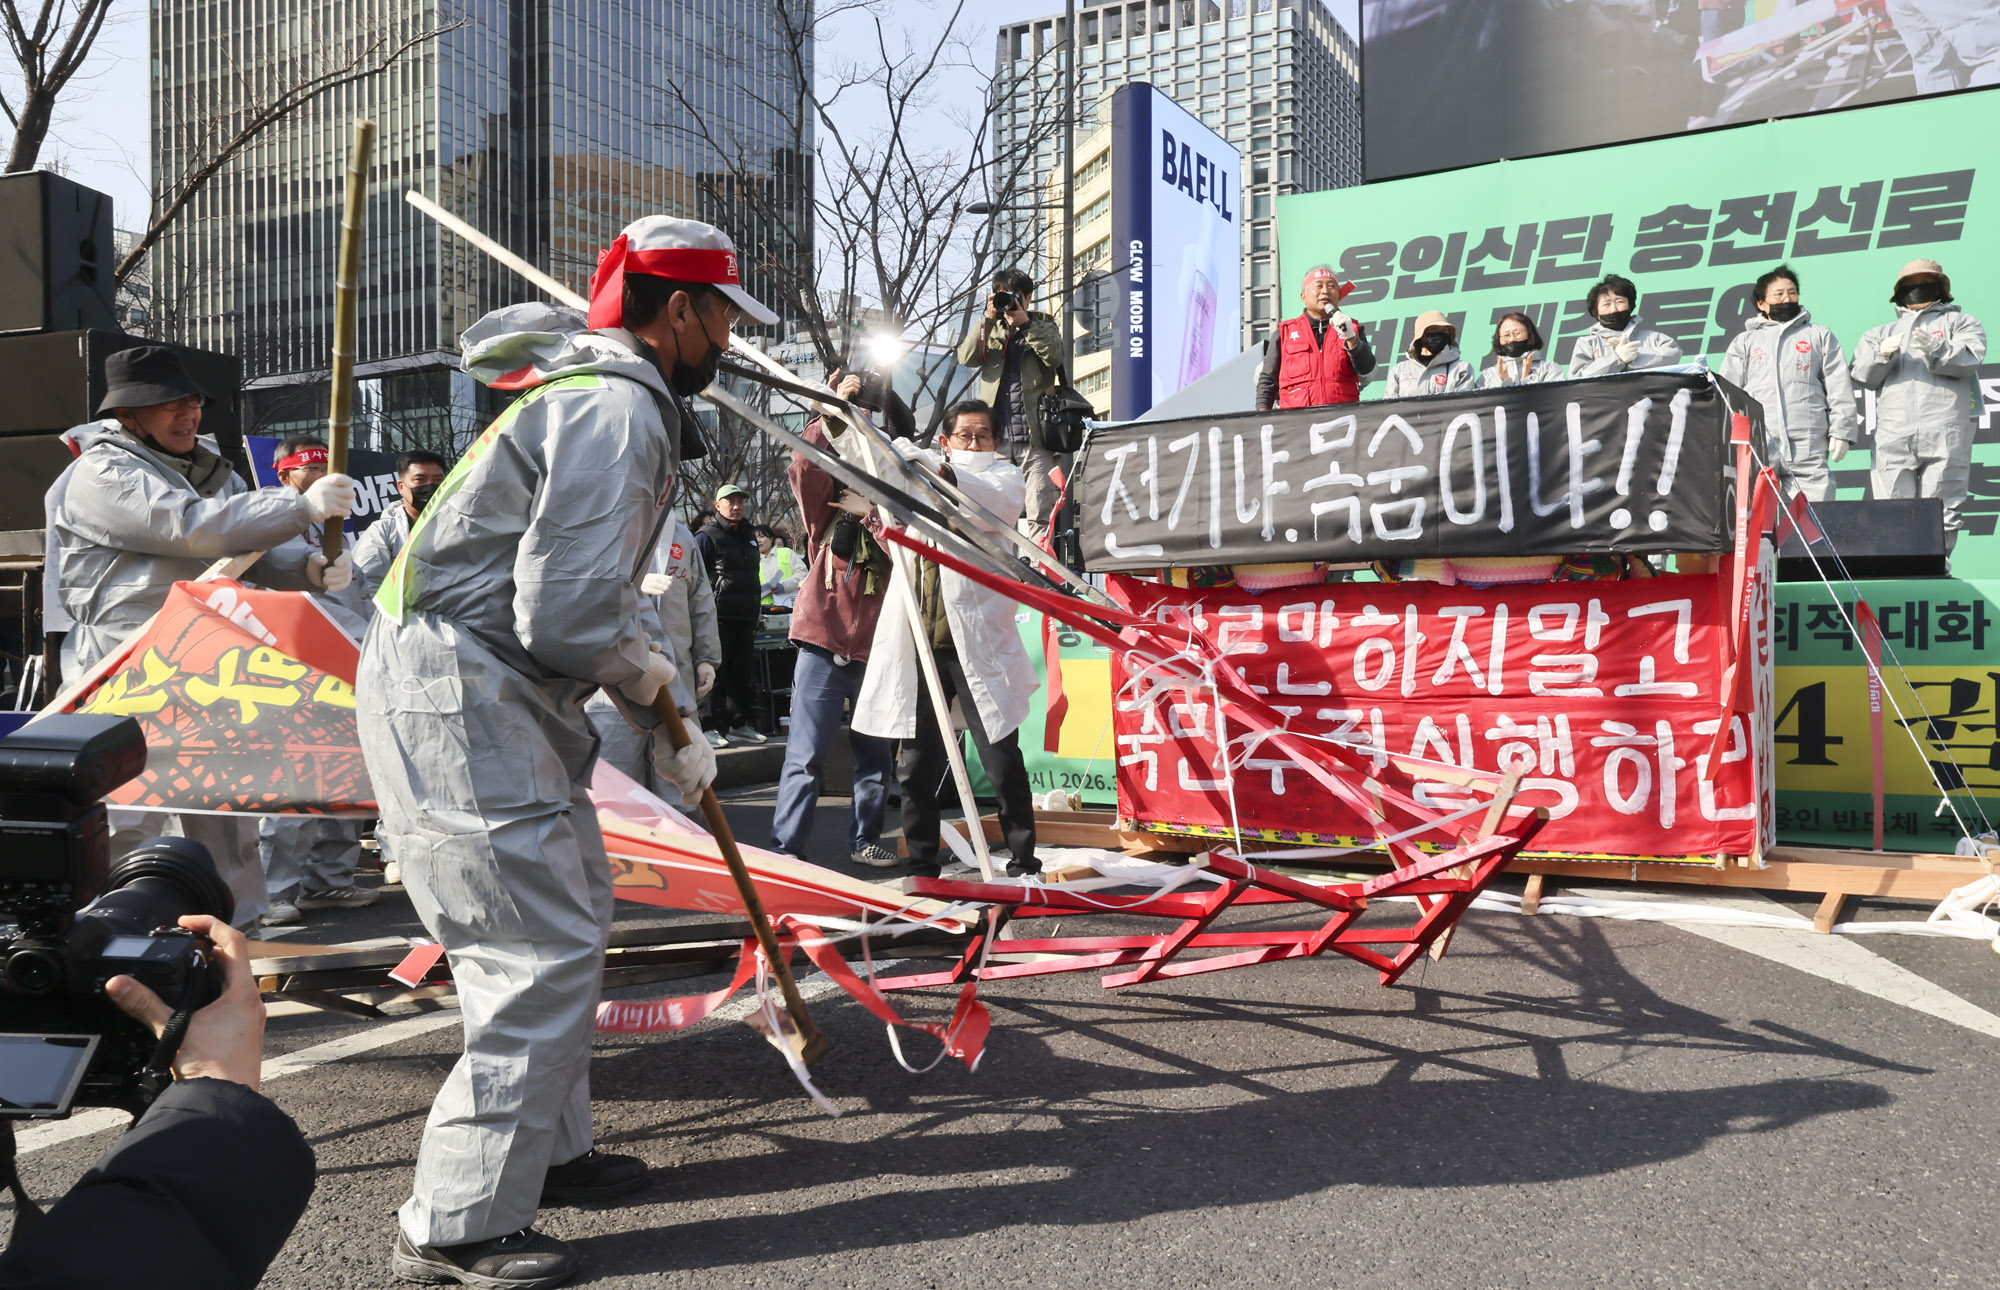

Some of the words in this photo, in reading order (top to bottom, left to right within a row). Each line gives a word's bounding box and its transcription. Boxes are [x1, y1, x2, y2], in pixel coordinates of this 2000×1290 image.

[1162, 127, 1232, 224] BAELL
[1336, 212, 1613, 306] 용인산단
[1629, 168, 1976, 274] 송전선로
[1130, 240, 1143, 283] GLOW
[1130, 291, 1143, 333] MODE
[1130, 337, 1143, 357] ON
[1878, 600, 1991, 651] 대화
[1832, 808, 1918, 836] 반도체
